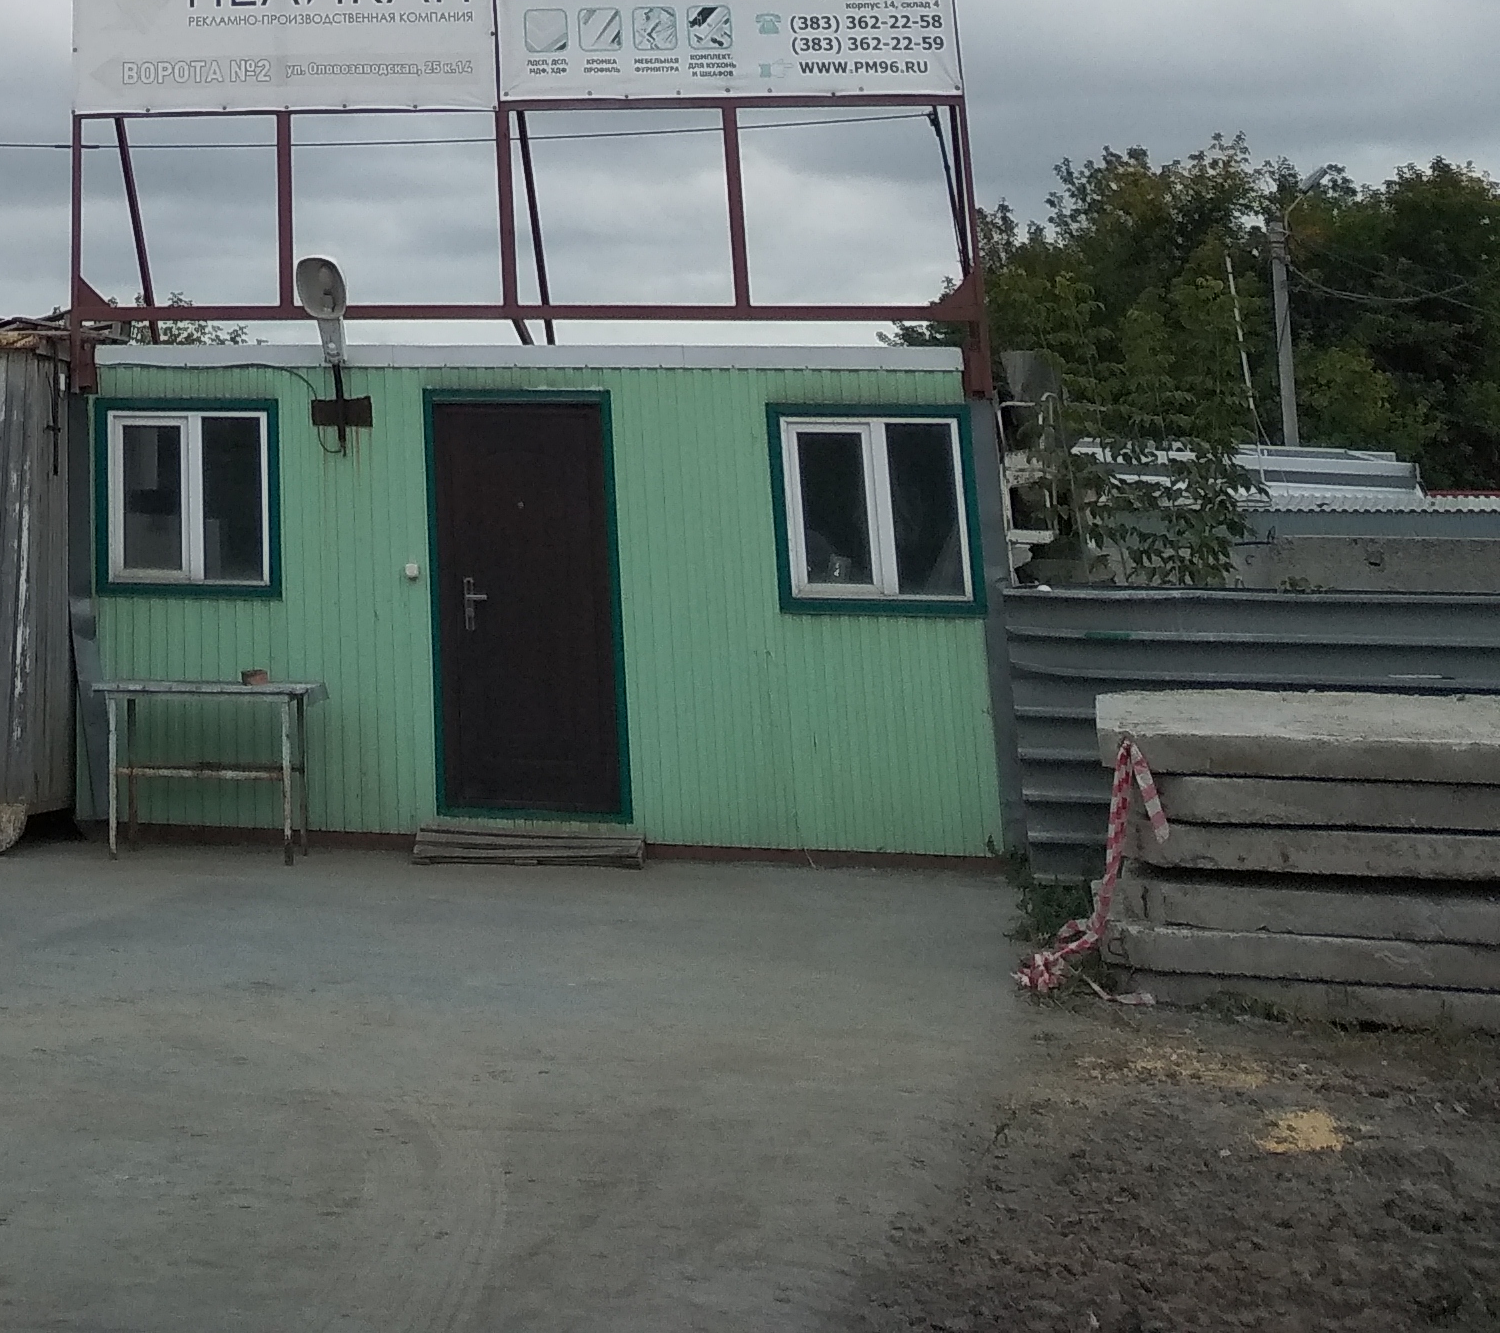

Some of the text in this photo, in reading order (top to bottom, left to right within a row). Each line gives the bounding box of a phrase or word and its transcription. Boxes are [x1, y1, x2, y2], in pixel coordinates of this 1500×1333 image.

[845, 0, 940, 11] корпус 14, склад 4
[187, 10, 474, 28] РЕКЛАМНО-ПРОИЗВОДСТВЕННАЯ КОМПАНИЯ
[790, 14, 943, 34] (383) 362-22-58
[791, 36, 945, 55] (383) 362-22-59
[122, 58, 272, 85] ВОРОТА №2
[285, 64, 306, 79] ул.
[308, 61, 423, 77] Оловозаводская,
[423, 60, 441, 74] 25
[798, 60, 929, 75] WWW.PM96.RU
